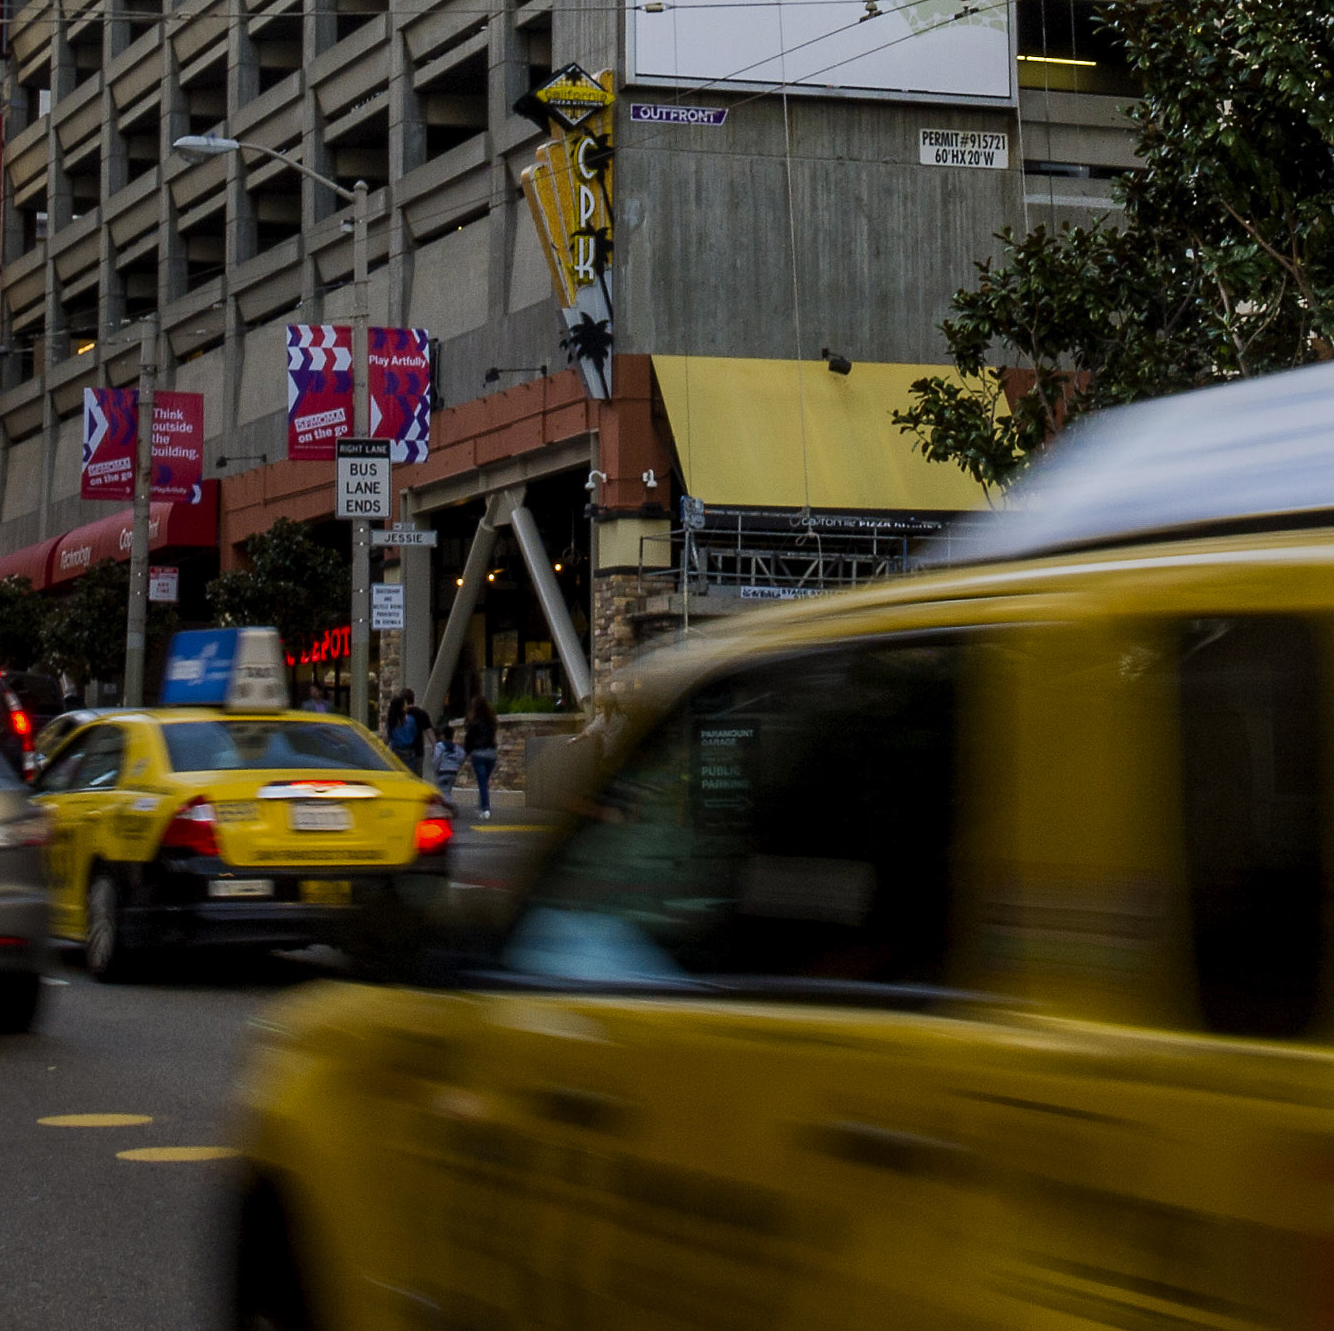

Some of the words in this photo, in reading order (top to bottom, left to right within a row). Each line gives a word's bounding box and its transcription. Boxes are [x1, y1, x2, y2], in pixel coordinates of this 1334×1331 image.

[639, 105, 716, 123] OUTFRONT
[574, 136, 599, 280] CPK
[368, 354, 389, 368] Play
[391, 354, 428, 368] Artfully
[154, 408, 183, 420] Think
[152, 421, 193, 433] outside
[298, 431, 313, 443] on
[313, 428, 332, 440] the
[334, 423, 348, 437] go
[151, 433, 170, 444] the
[151, 445, 199, 461] building.
[340, 444, 363, 454] RIGHT
[365, 444, 387, 453] LANE
[349, 463, 378, 476] BUS
[90, 477, 103, 486] on
[104, 473, 119, 483] the
[121, 470, 133, 481] go
[346, 481, 381, 494] LANE
[346, 499, 381, 513] ENDS
[384, 533, 423, 543] JESSIE
